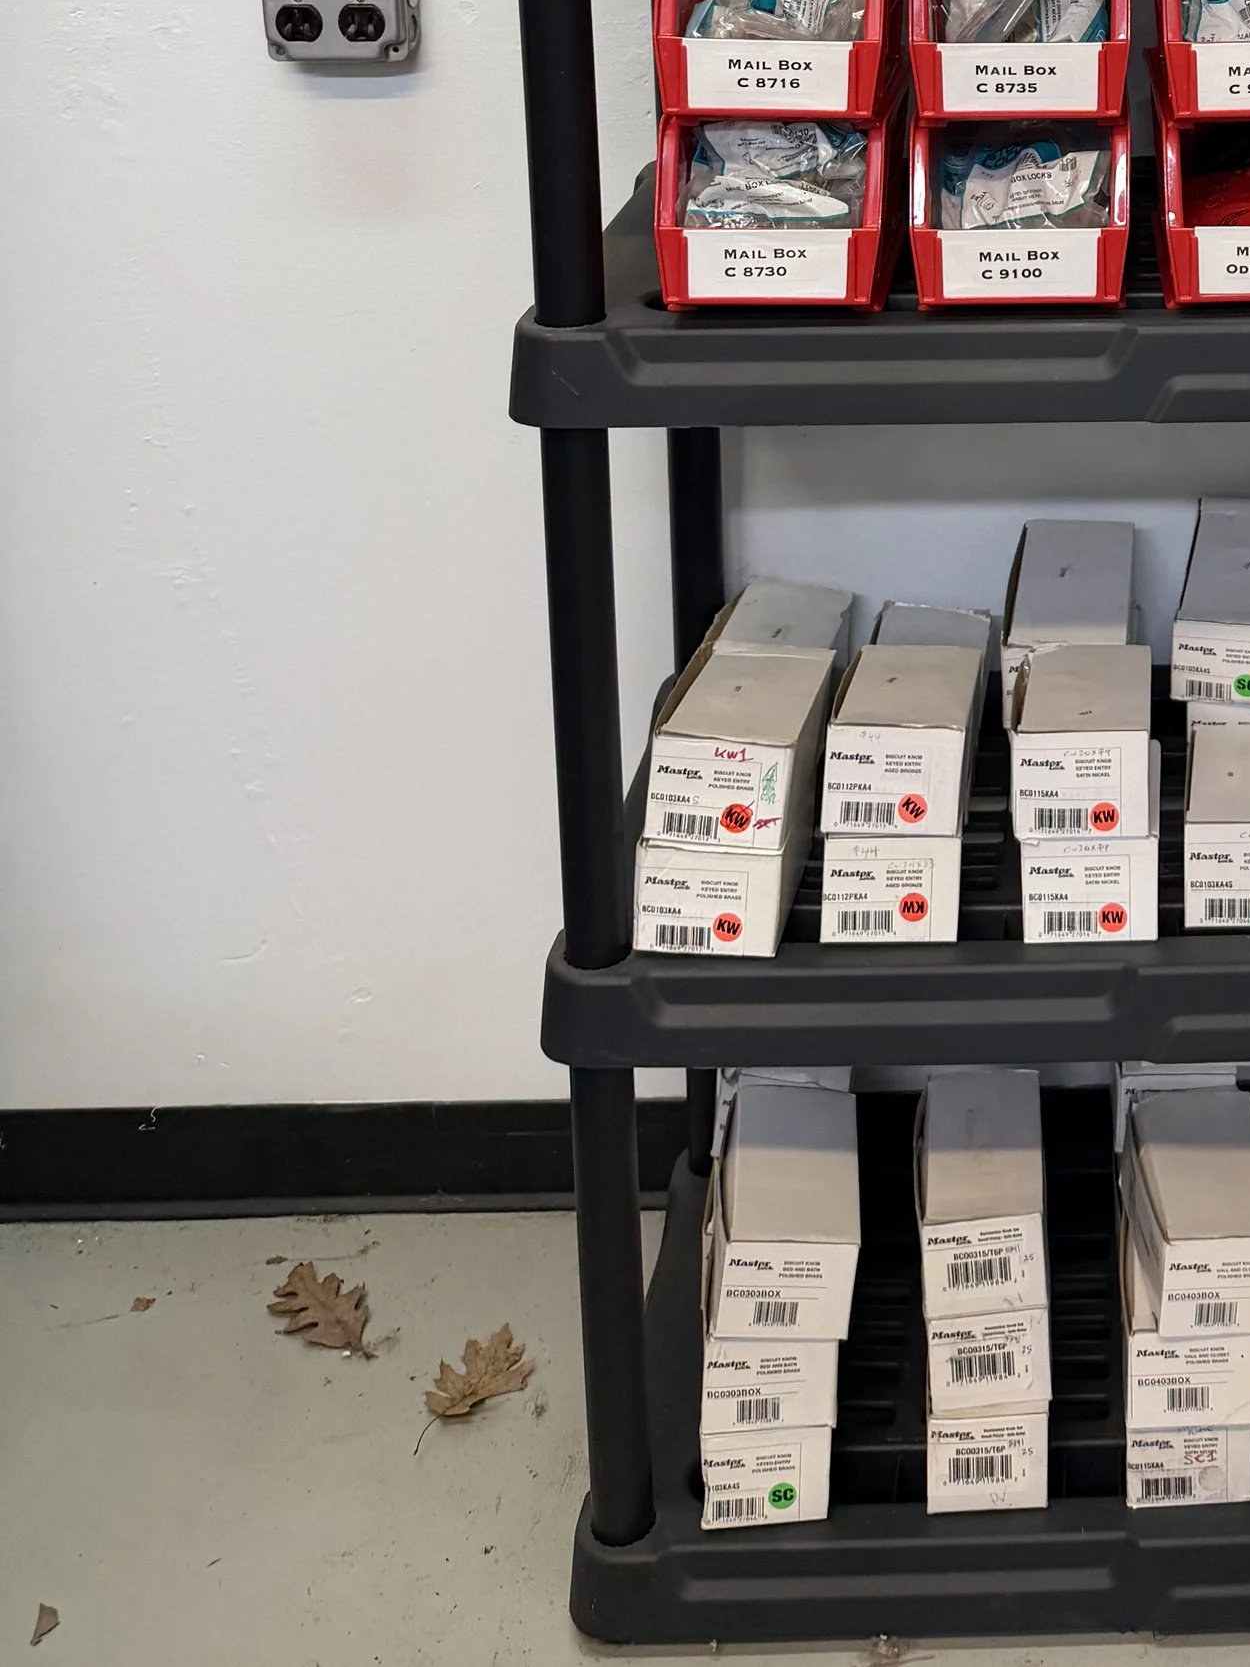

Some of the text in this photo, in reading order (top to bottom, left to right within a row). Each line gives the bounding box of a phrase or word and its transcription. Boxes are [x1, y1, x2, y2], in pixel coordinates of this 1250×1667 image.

[737, 77, 801, 89] C 8716
[976, 82, 1038, 93] C 8735
[1229, 84, 1240, 94] C
[724, 266, 788, 277] C 8730
[981, 267, 1043, 279] C 9100
[1173, 664, 1211, 674] BC0103KA4S
[714, 747, 754, 762] KW1
[828, 782, 872, 791] BC0112PKA4
[651, 793, 691, 803] BC0103KA4
[1019, 789, 1059, 798] BC0115KA4
[901, 797, 926, 819] KW
[725, 808, 749, 829] KW
[1094, 809, 1114, 824] KW
[1190, 880, 1233, 889] BC0103KA4S
[823, 893, 868, 901] BC0112PKA4
[1028, 893, 1069, 902] BC0115KA4
[642, 906, 682, 915] BC0103KA4
[902, 902, 925, 914] KW
[1101, 909, 1125, 924] KW
[716, 921, 740, 934] KW
[953, 1249, 1003, 1260] BC00315/T6P
[726, 1289, 781, 1298] BC0303BOX
[1168, 1292, 1220, 1301] BC0403BOX
[958, 1344, 1007, 1355] BC00315/T6P
[1138, 1377, 1191, 1386] BC0403BOX
[707, 1388, 761, 1398] BC0303BOX
[956, 1446, 1006, 1456] BC00315/T6P
[1183, 1452, 1218, 1465] SC1
[771, 1488, 794, 1502] SC
